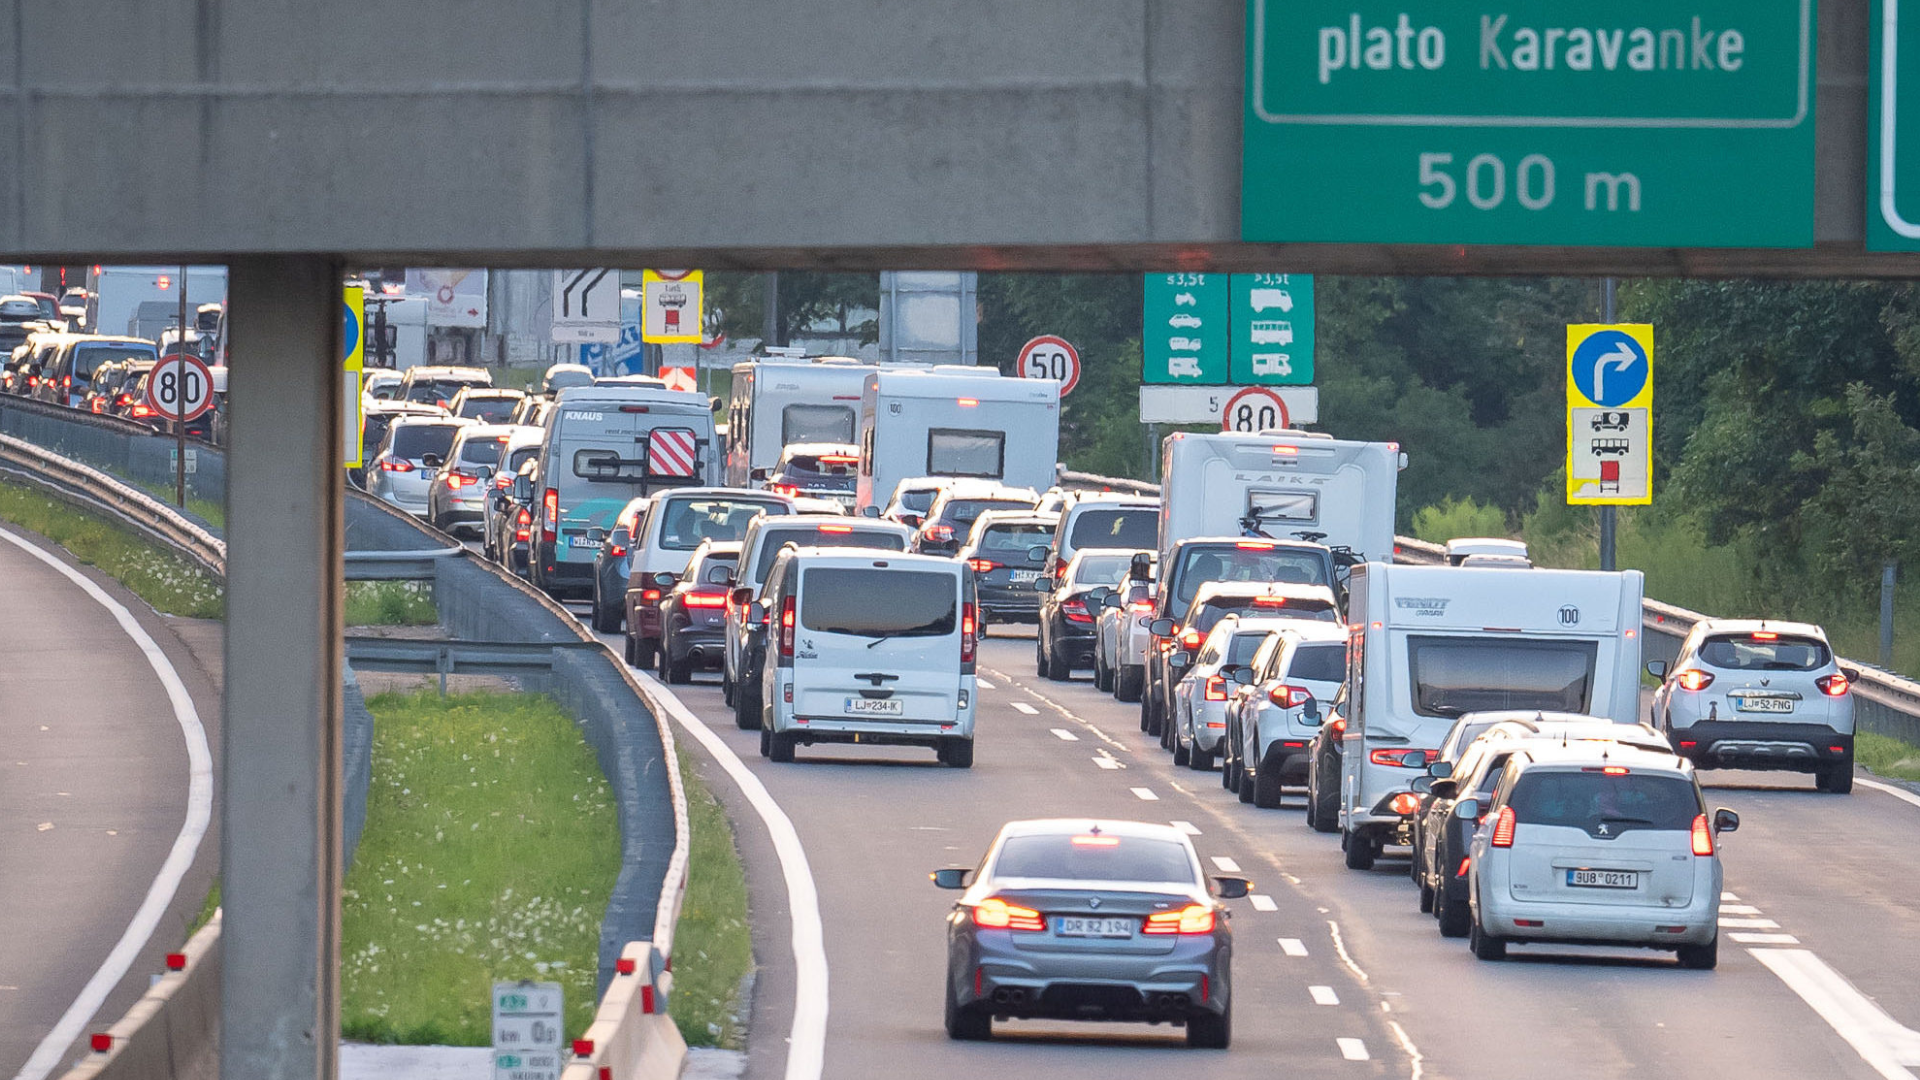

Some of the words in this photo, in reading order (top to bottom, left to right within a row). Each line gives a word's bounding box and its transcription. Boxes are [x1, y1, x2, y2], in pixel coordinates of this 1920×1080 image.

[1318, 12, 1446, 85] plato
[1479, 14, 1745, 72] Karavanke
[1418, 152, 1556, 211] 500
[1584, 171, 1641, 212] m
[1032, 353, 1066, 381] 50
[160, 371, 200, 404] 80
[565, 411, 603, 421] KNAUS
[1236, 404, 1275, 432] 80
[1559, 608, 1579, 624] 100
[1576, 872, 1597, 884] 9U8
[1605, 873, 1632, 886] 0211
